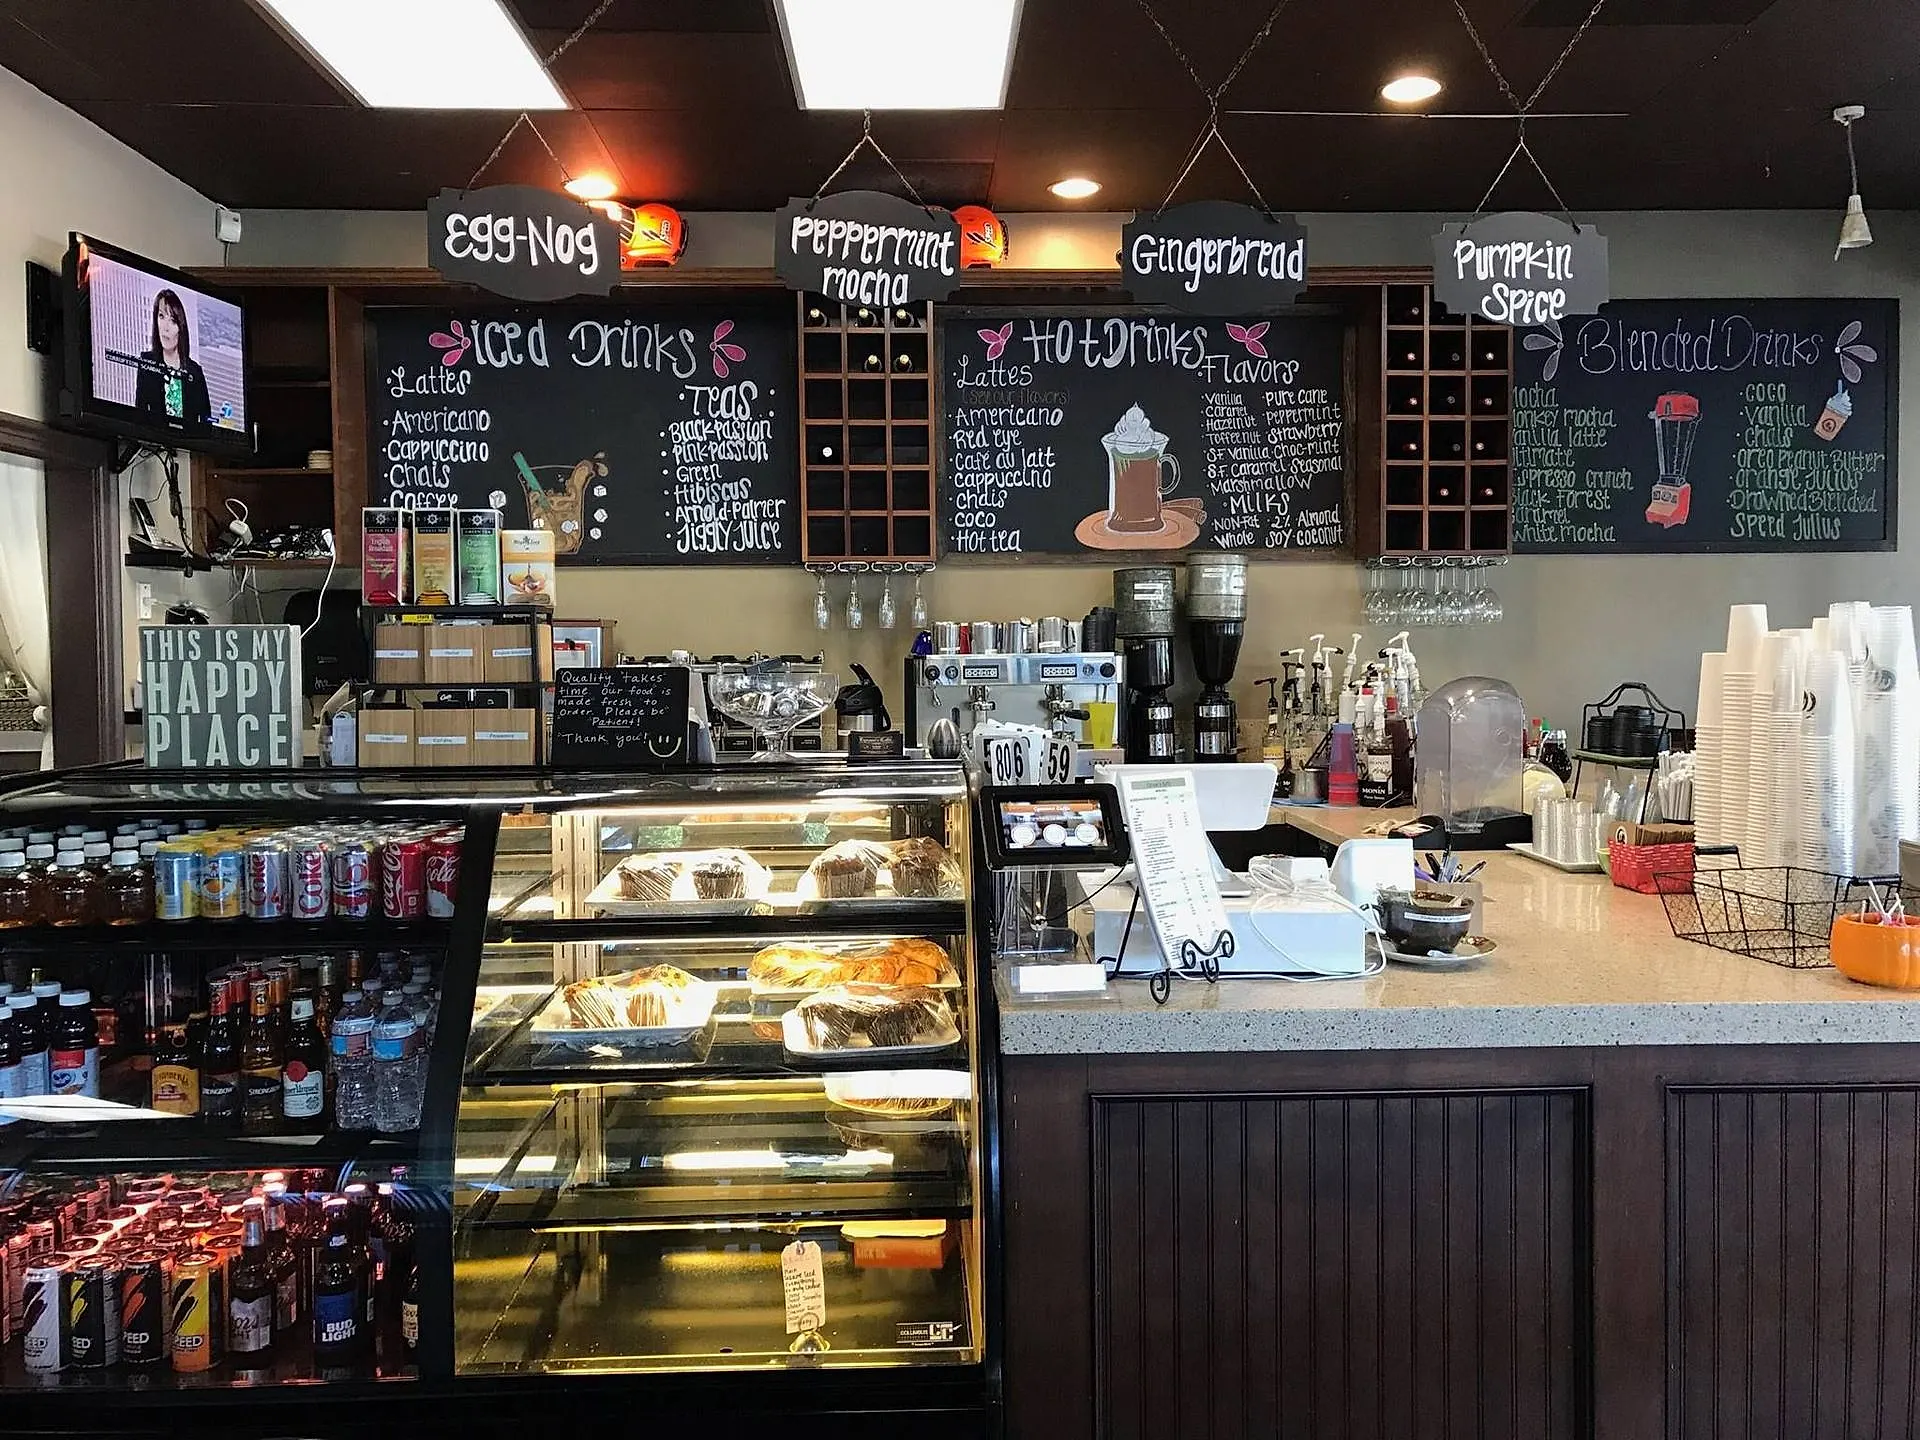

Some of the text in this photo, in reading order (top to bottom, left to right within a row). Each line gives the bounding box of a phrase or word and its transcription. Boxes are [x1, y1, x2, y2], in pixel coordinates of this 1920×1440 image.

[444, 213, 598, 275] Egg-Nog
[791, 216, 955, 276] Peppermint
[1131, 233, 1304, 293] Gingerbread
[1454, 239, 1574, 281] Pumpkin
[1480, 282, 1566, 324] Spice
[568, 319, 698, 379] Drinks
[1023, 318, 1208, 369] Hot Drinks
[1577, 314, 1824, 374] Blended Drinks
[957, 354, 1033, 389] Lattes
[1201, 354, 1300, 385] Flavors
[390, 366, 471, 398] Lattes
[684, 380, 759, 420] Teas
[1205, 390, 1243, 405] Vanilla
[392, 406, 491, 436] Americano
[955, 404, 1064, 427] Americano
[1205, 405, 1248, 417] Caramel
[1564, 406, 1617, 428] mocha
[1206, 415, 1258, 432] Hazelnut
[1267, 421, 1343, 445] Strawberry
[953, 425, 1022, 452] Red eye
[1569, 427, 1608, 448] latte
[388, 439, 489, 462] Cappuccino
[996, 452, 1015, 469] au
[1021, 446, 1056, 468] lait
[1230, 444, 1270, 461] Vanilla
[1830, 450, 1885, 472] Butter
[390, 461, 451, 488] Chais
[676, 463, 722, 483] Green
[1231, 459, 1287, 477] Caramel
[1289, 455, 1343, 474] Seasonal
[674, 478, 751, 504] Hibiscus
[1210, 473, 1313, 496] Marshmallow
[1586, 468, 1634, 491] crunch
[1805, 469, 1863, 492] Julius
[1230, 492, 1290, 516] Milks
[1557, 488, 1611, 511] Forest
[1808, 489, 1878, 513] Blended
[1270, 515, 1290, 529] 2%
[1298, 504, 1341, 528] Almond
[1730, 512, 1841, 541] Speed Julius
[956, 529, 1022, 553] Hot tea
[1213, 530, 1256, 550] Whole
[1561, 523, 1617, 542] mocha
[143, 630, 285, 661] THIS IS MY
[146, 661, 285, 714] HAPPY
[561, 671, 663, 687] Quality takes
[558, 698, 591, 706] made
[601, 698, 632, 706] fresh
[559, 686, 588, 697] time
[629, 686, 653, 695] food
[605, 707, 645, 716] Please
[149, 714, 288, 767] PLACE
[561, 732, 647, 748] Thank you!
[1048, 743, 1070, 783] 59
[300, 851, 323, 914] Coke
[321, 1325, 357, 1342] LIGHT
[326, 1318, 353, 1332] BUD
